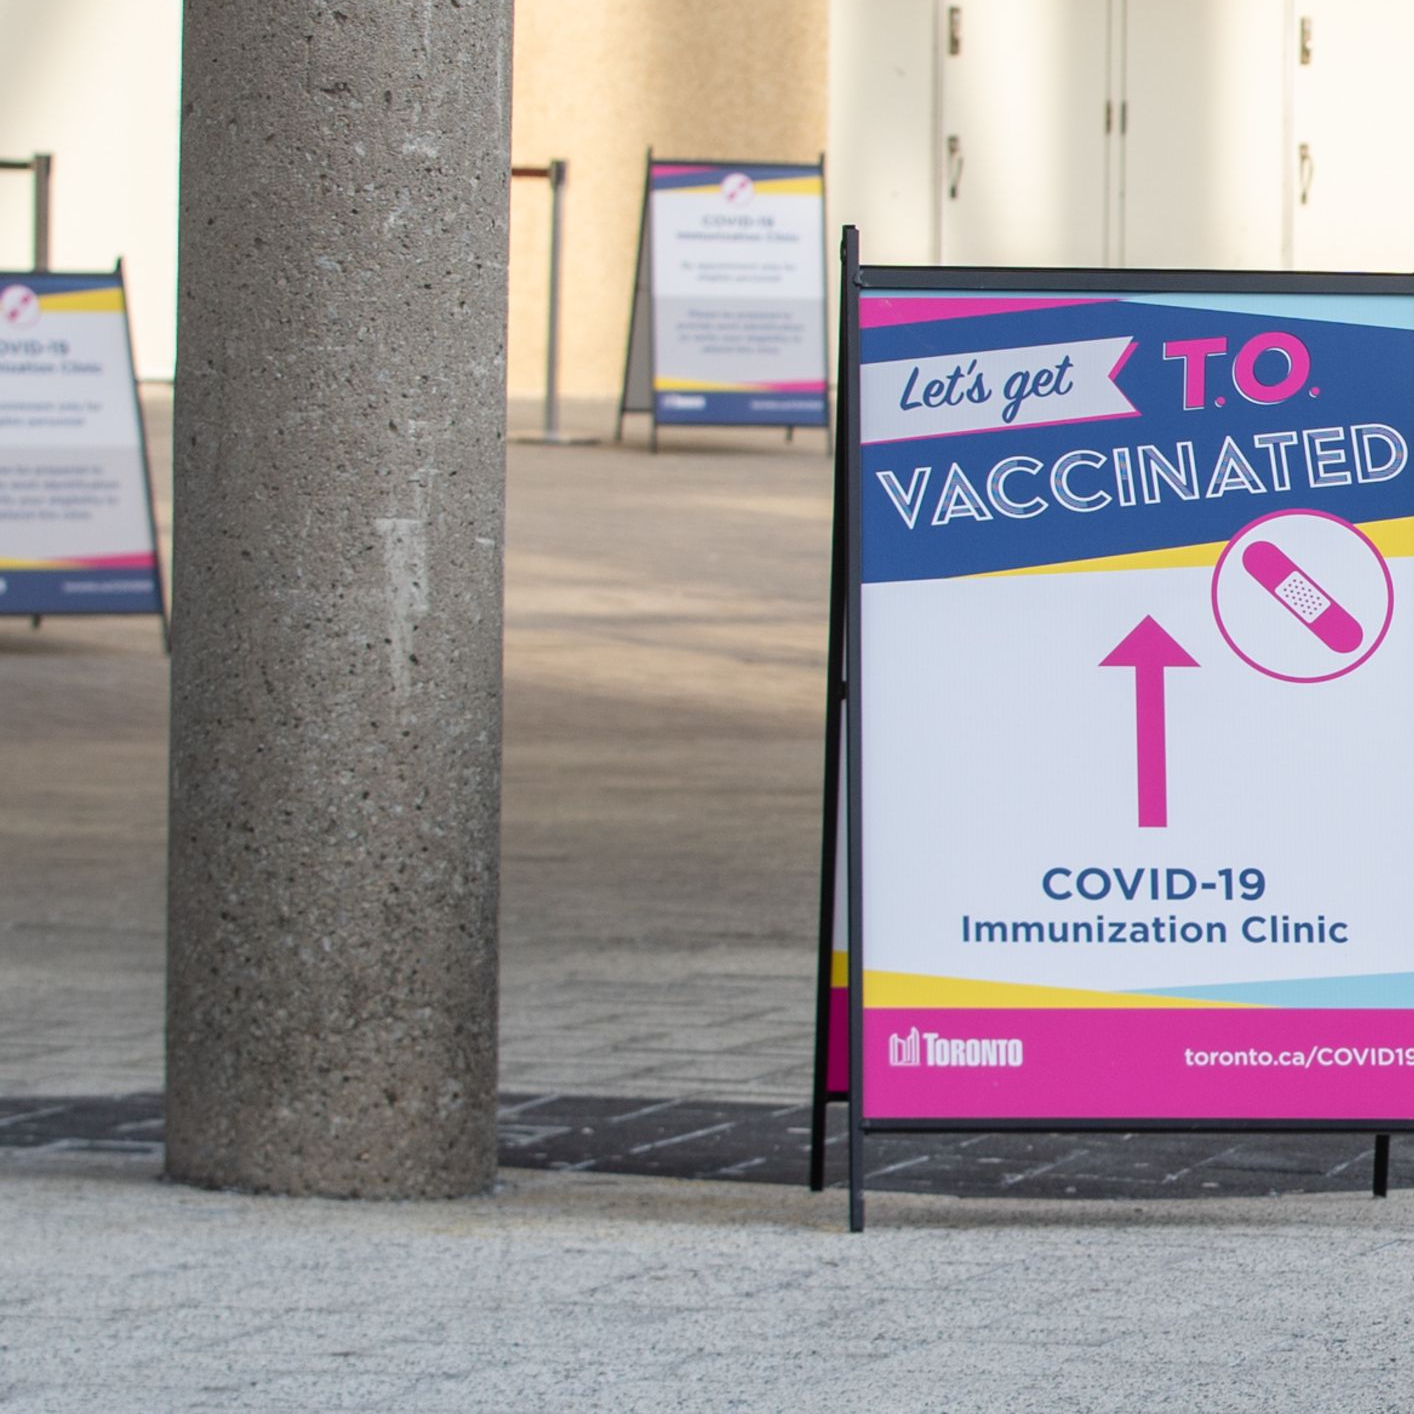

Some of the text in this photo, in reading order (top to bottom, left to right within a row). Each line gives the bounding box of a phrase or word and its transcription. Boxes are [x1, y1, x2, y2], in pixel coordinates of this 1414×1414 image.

[899, 331, 1321, 424] Let's get T.O.
[876, 422, 1409, 531] VACCINATED
[1042, 867, 1267, 902] COVID-19
[961, 915, 1349, 944] Immunization Clinic
[923, 1032, 1023, 1068] TORONTO
